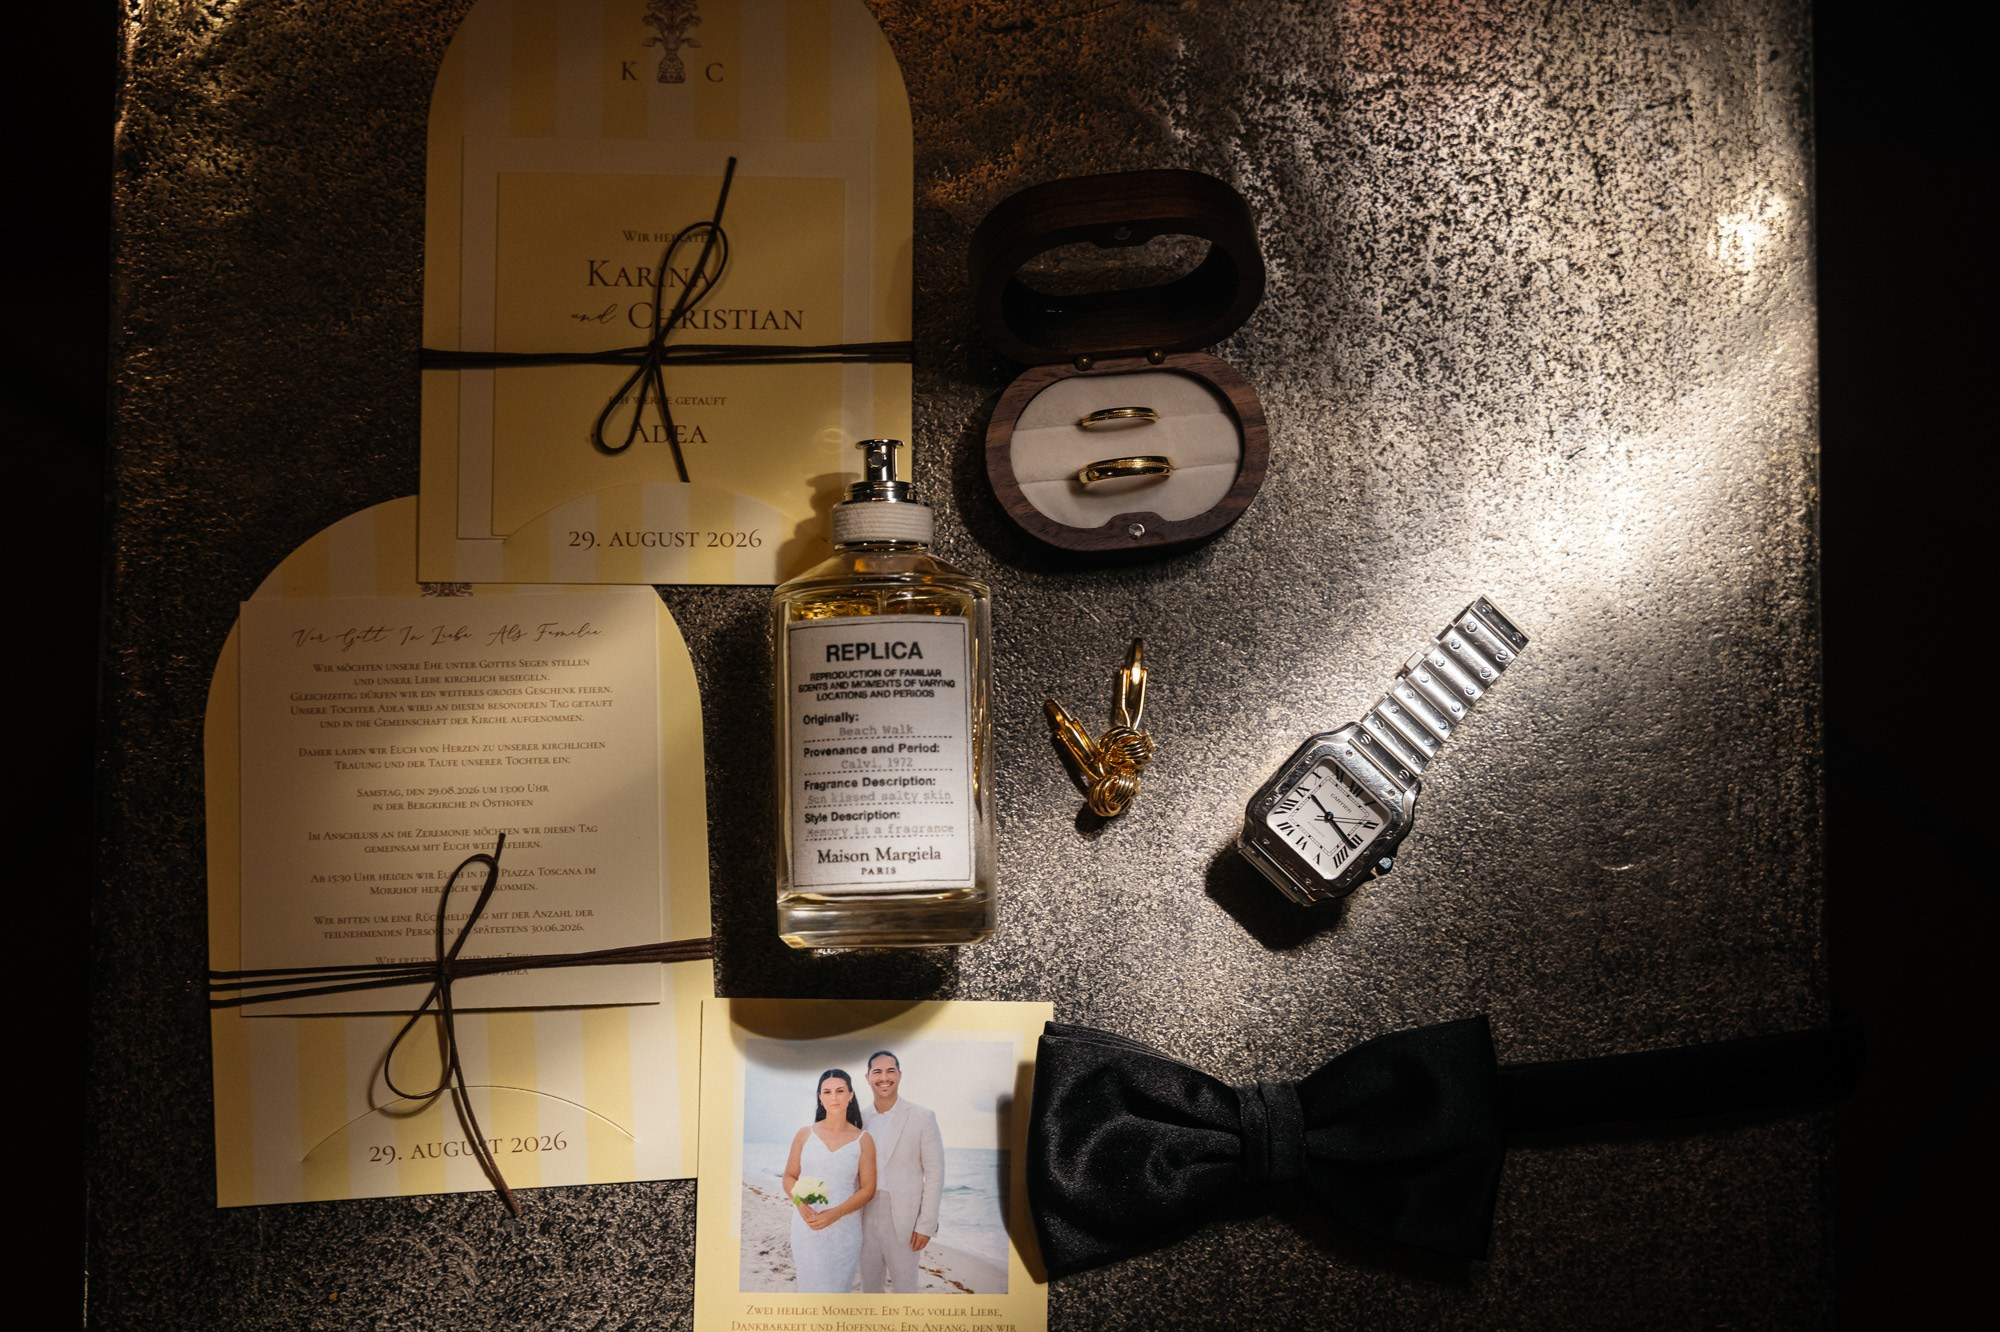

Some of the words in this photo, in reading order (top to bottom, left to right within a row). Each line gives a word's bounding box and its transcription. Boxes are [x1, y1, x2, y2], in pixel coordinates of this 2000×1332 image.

[621, 61, 638, 81] K
[705, 62, 724, 82] C
[675, 396, 727, 406] GETAUFT
[569, 531, 601, 550] 29.
[609, 532, 699, 547] AUGUST
[707, 530, 761, 547] 2026
[826, 642, 923, 662] REPLICA
[809, 670, 882, 681] REPRODUCTION
[899, 668, 942, 677] FAMILIAR
[798, 683, 828, 693] SCENTS
[851, 680, 902, 688] MOMENTS
[918, 679, 956, 688] VARYING
[816, 691, 868, 701] LOCATIONS
[869, 690, 891, 698] AND
[893, 689, 935, 698] PERIODS
[803, 712, 859, 726] Originally:
[839, 725, 877, 736] Beach
[882, 724, 914, 735] Walk
[803, 745, 867, 758] Provenance
[872, 744, 894, 754] and
[899, 743, 940, 753] Period:
[841, 758, 882, 770] Calvi,
[887, 757, 913, 768] 1972
[804, 779, 858, 792] Fragrance
[862, 777, 936, 788] Description:
[807, 794, 827, 805] Sun
[831, 792, 875, 803] kissed
[881, 791, 918, 803] salty
[923, 790, 951, 800] skin
[1330, 793, 1352, 814] CARTIER
[804, 812, 827, 825] Style
[831, 811, 900, 823] Description:
[806, 827, 848, 838] Memory
[888, 823, 954, 835] fragrance
[817, 849, 870, 864] Maison
[876, 847, 941, 863] Margiela
[861, 866, 897, 876] PARIS
[370, 1145, 402, 1164] 29.
[411, 1137, 502, 1159] AUGUT
[511, 1131, 567, 1153] 2026
